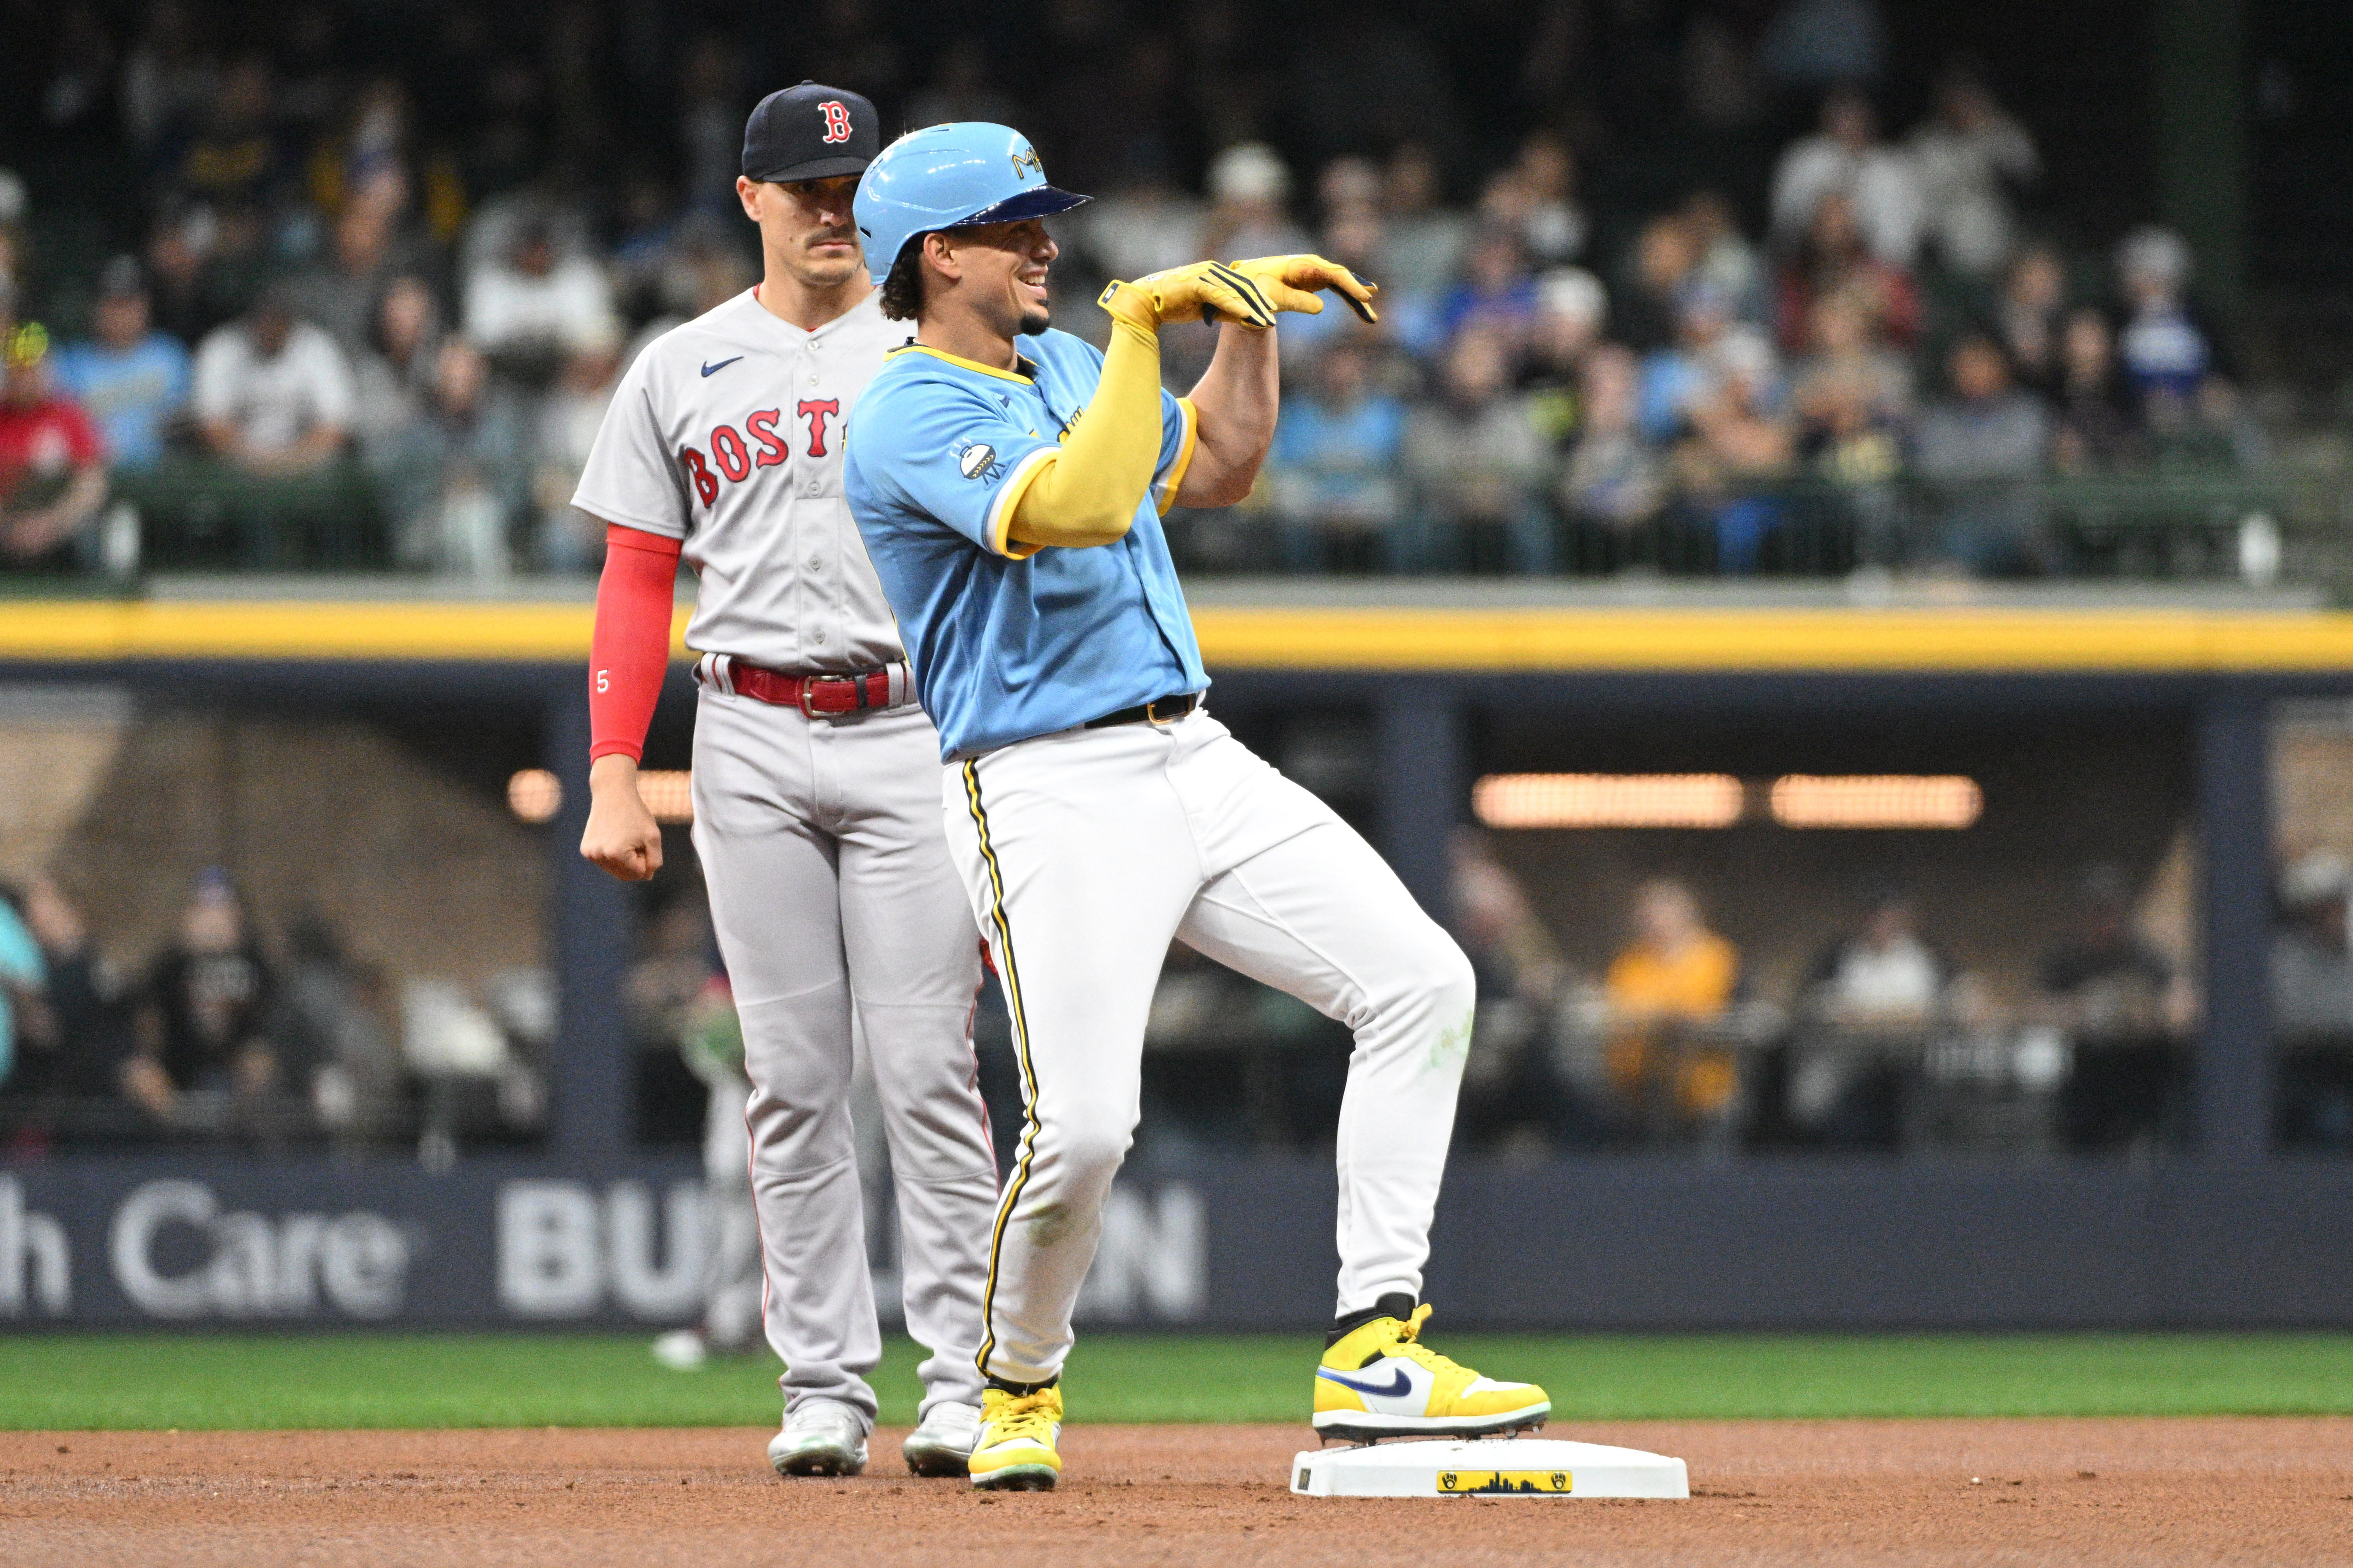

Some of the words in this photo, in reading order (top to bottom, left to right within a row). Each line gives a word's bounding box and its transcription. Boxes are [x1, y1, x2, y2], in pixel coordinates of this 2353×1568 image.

[818, 101, 853, 143] B
[685, 398, 839, 509] BOST
[597, 669, 609, 693] 5
[108, 1178, 407, 1319] Care
